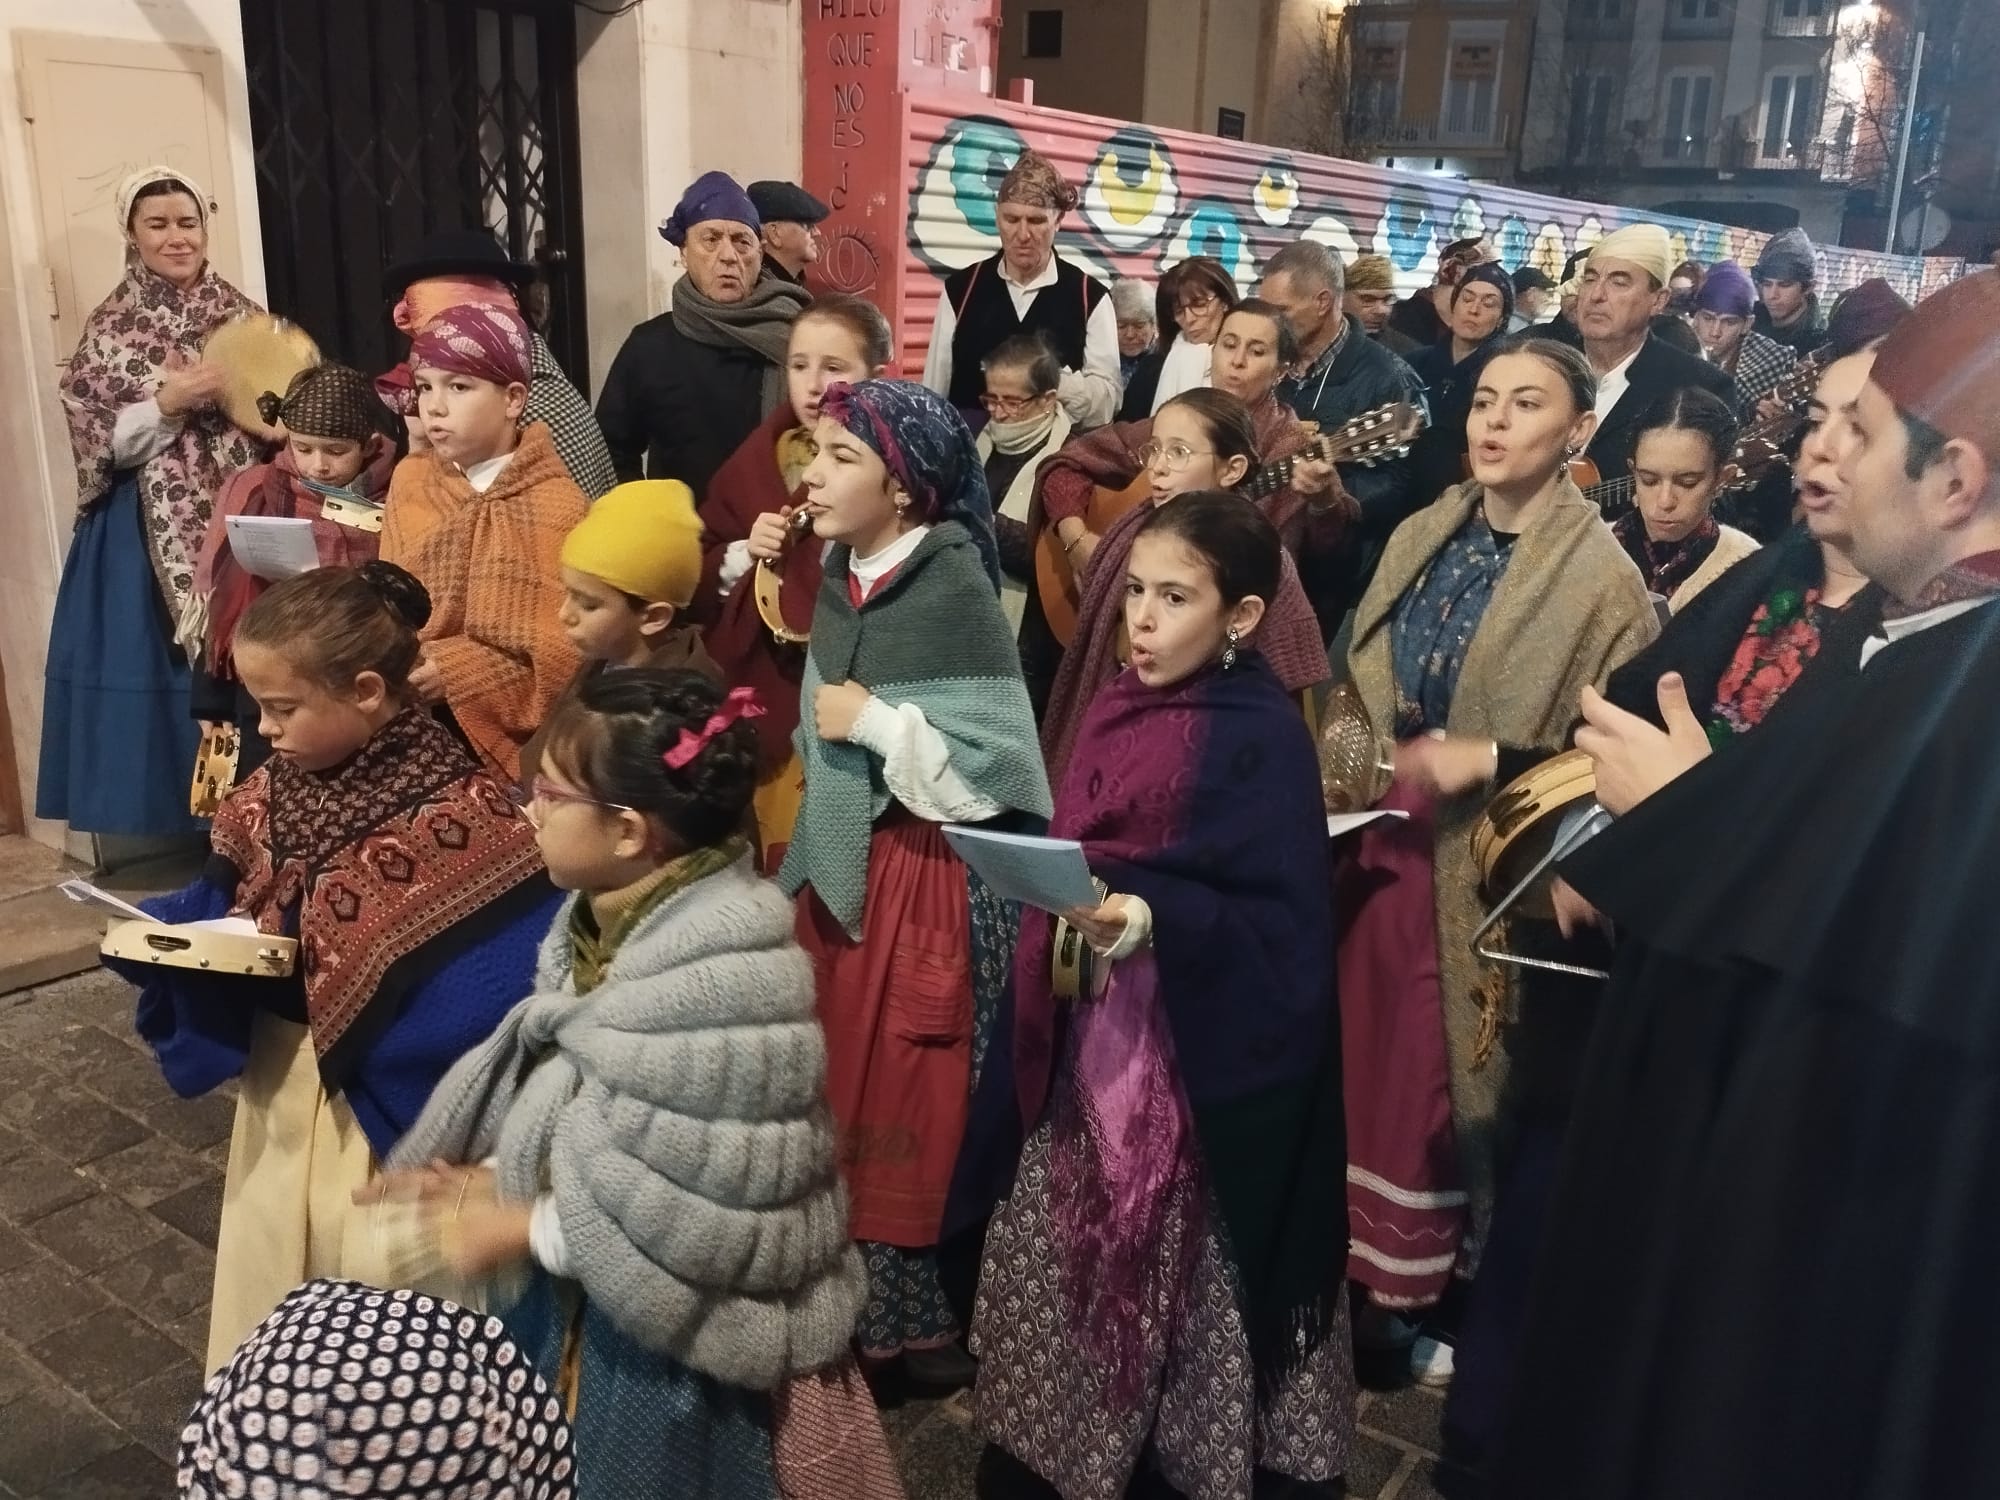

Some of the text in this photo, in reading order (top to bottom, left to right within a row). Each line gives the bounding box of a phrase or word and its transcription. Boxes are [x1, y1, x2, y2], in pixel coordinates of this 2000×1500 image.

[827, 32, 875, 68] QUE
[833, 81, 865, 115] NO
[832, 118, 866, 149] ES
